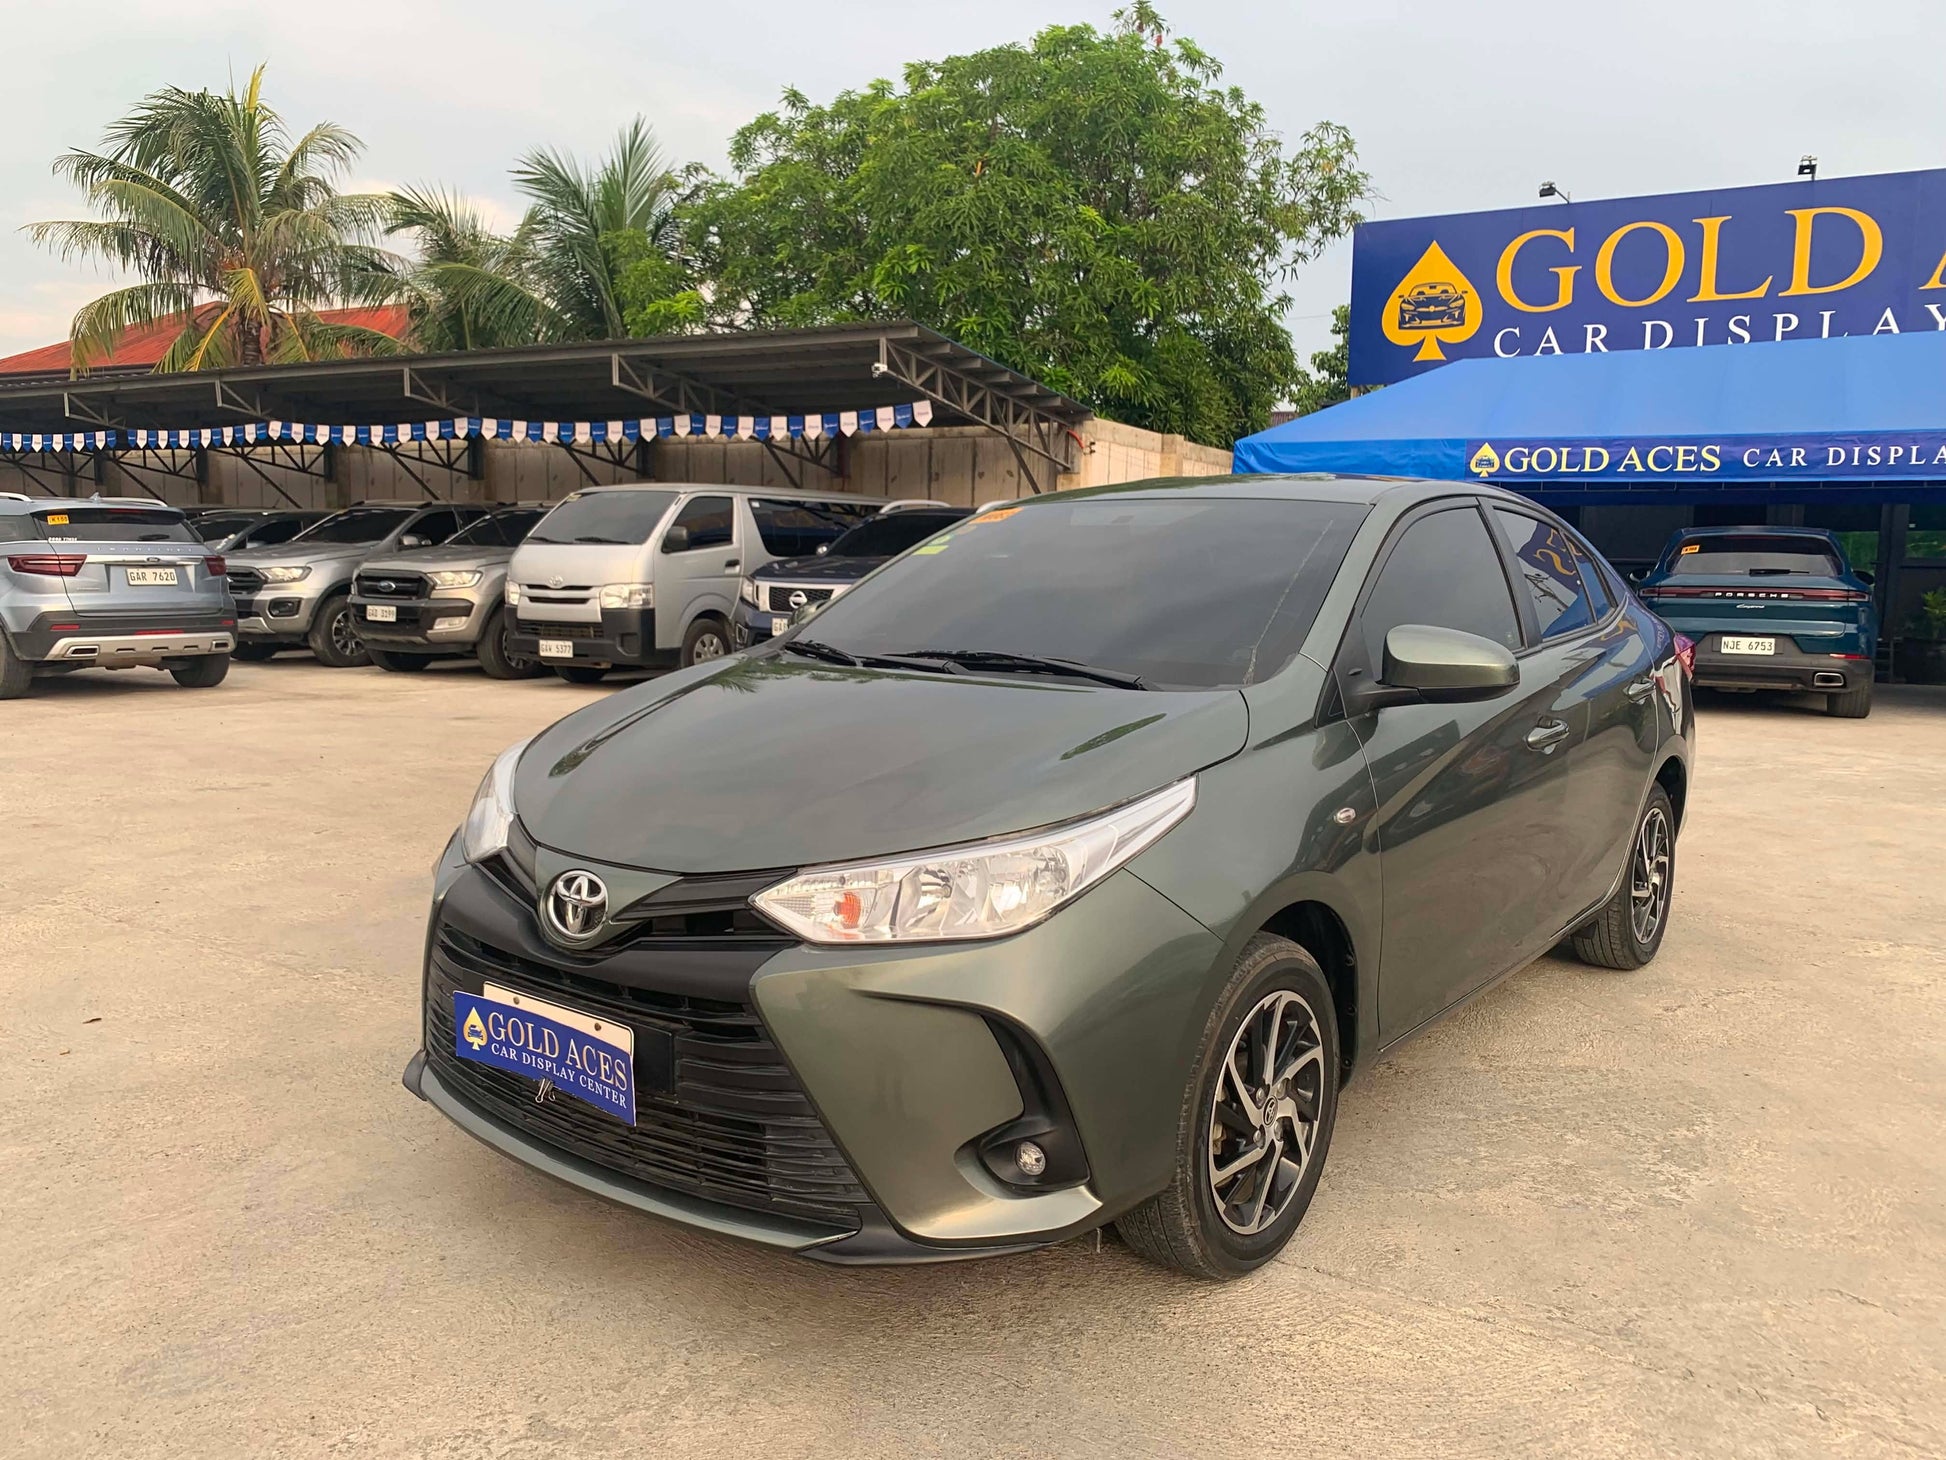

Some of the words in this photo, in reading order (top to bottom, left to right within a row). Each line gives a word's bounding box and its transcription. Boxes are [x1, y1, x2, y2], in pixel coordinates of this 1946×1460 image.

[1495, 206, 1884, 314] GOLD
[1493, 324, 1610, 359] CAR
[1504, 447, 1610, 473] GOLD
[1616, 445, 1721, 473] ACES
[1743, 447, 1808, 468] CAR
[1826, 445, 1946, 467] DISPLA
[129, 571, 147, 582] GAR
[152, 571, 176, 582] 7620
[1723, 640, 1741, 650] NJE
[1747, 641, 1773, 651] 6753
[488, 1011, 560, 1059] GOLD
[565, 1038, 628, 1092] ACES
[491, 1043, 518, 1061] CAR
[521, 1051, 576, 1082] DISPLAY
[579, 1075, 628, 1109] CENTER
